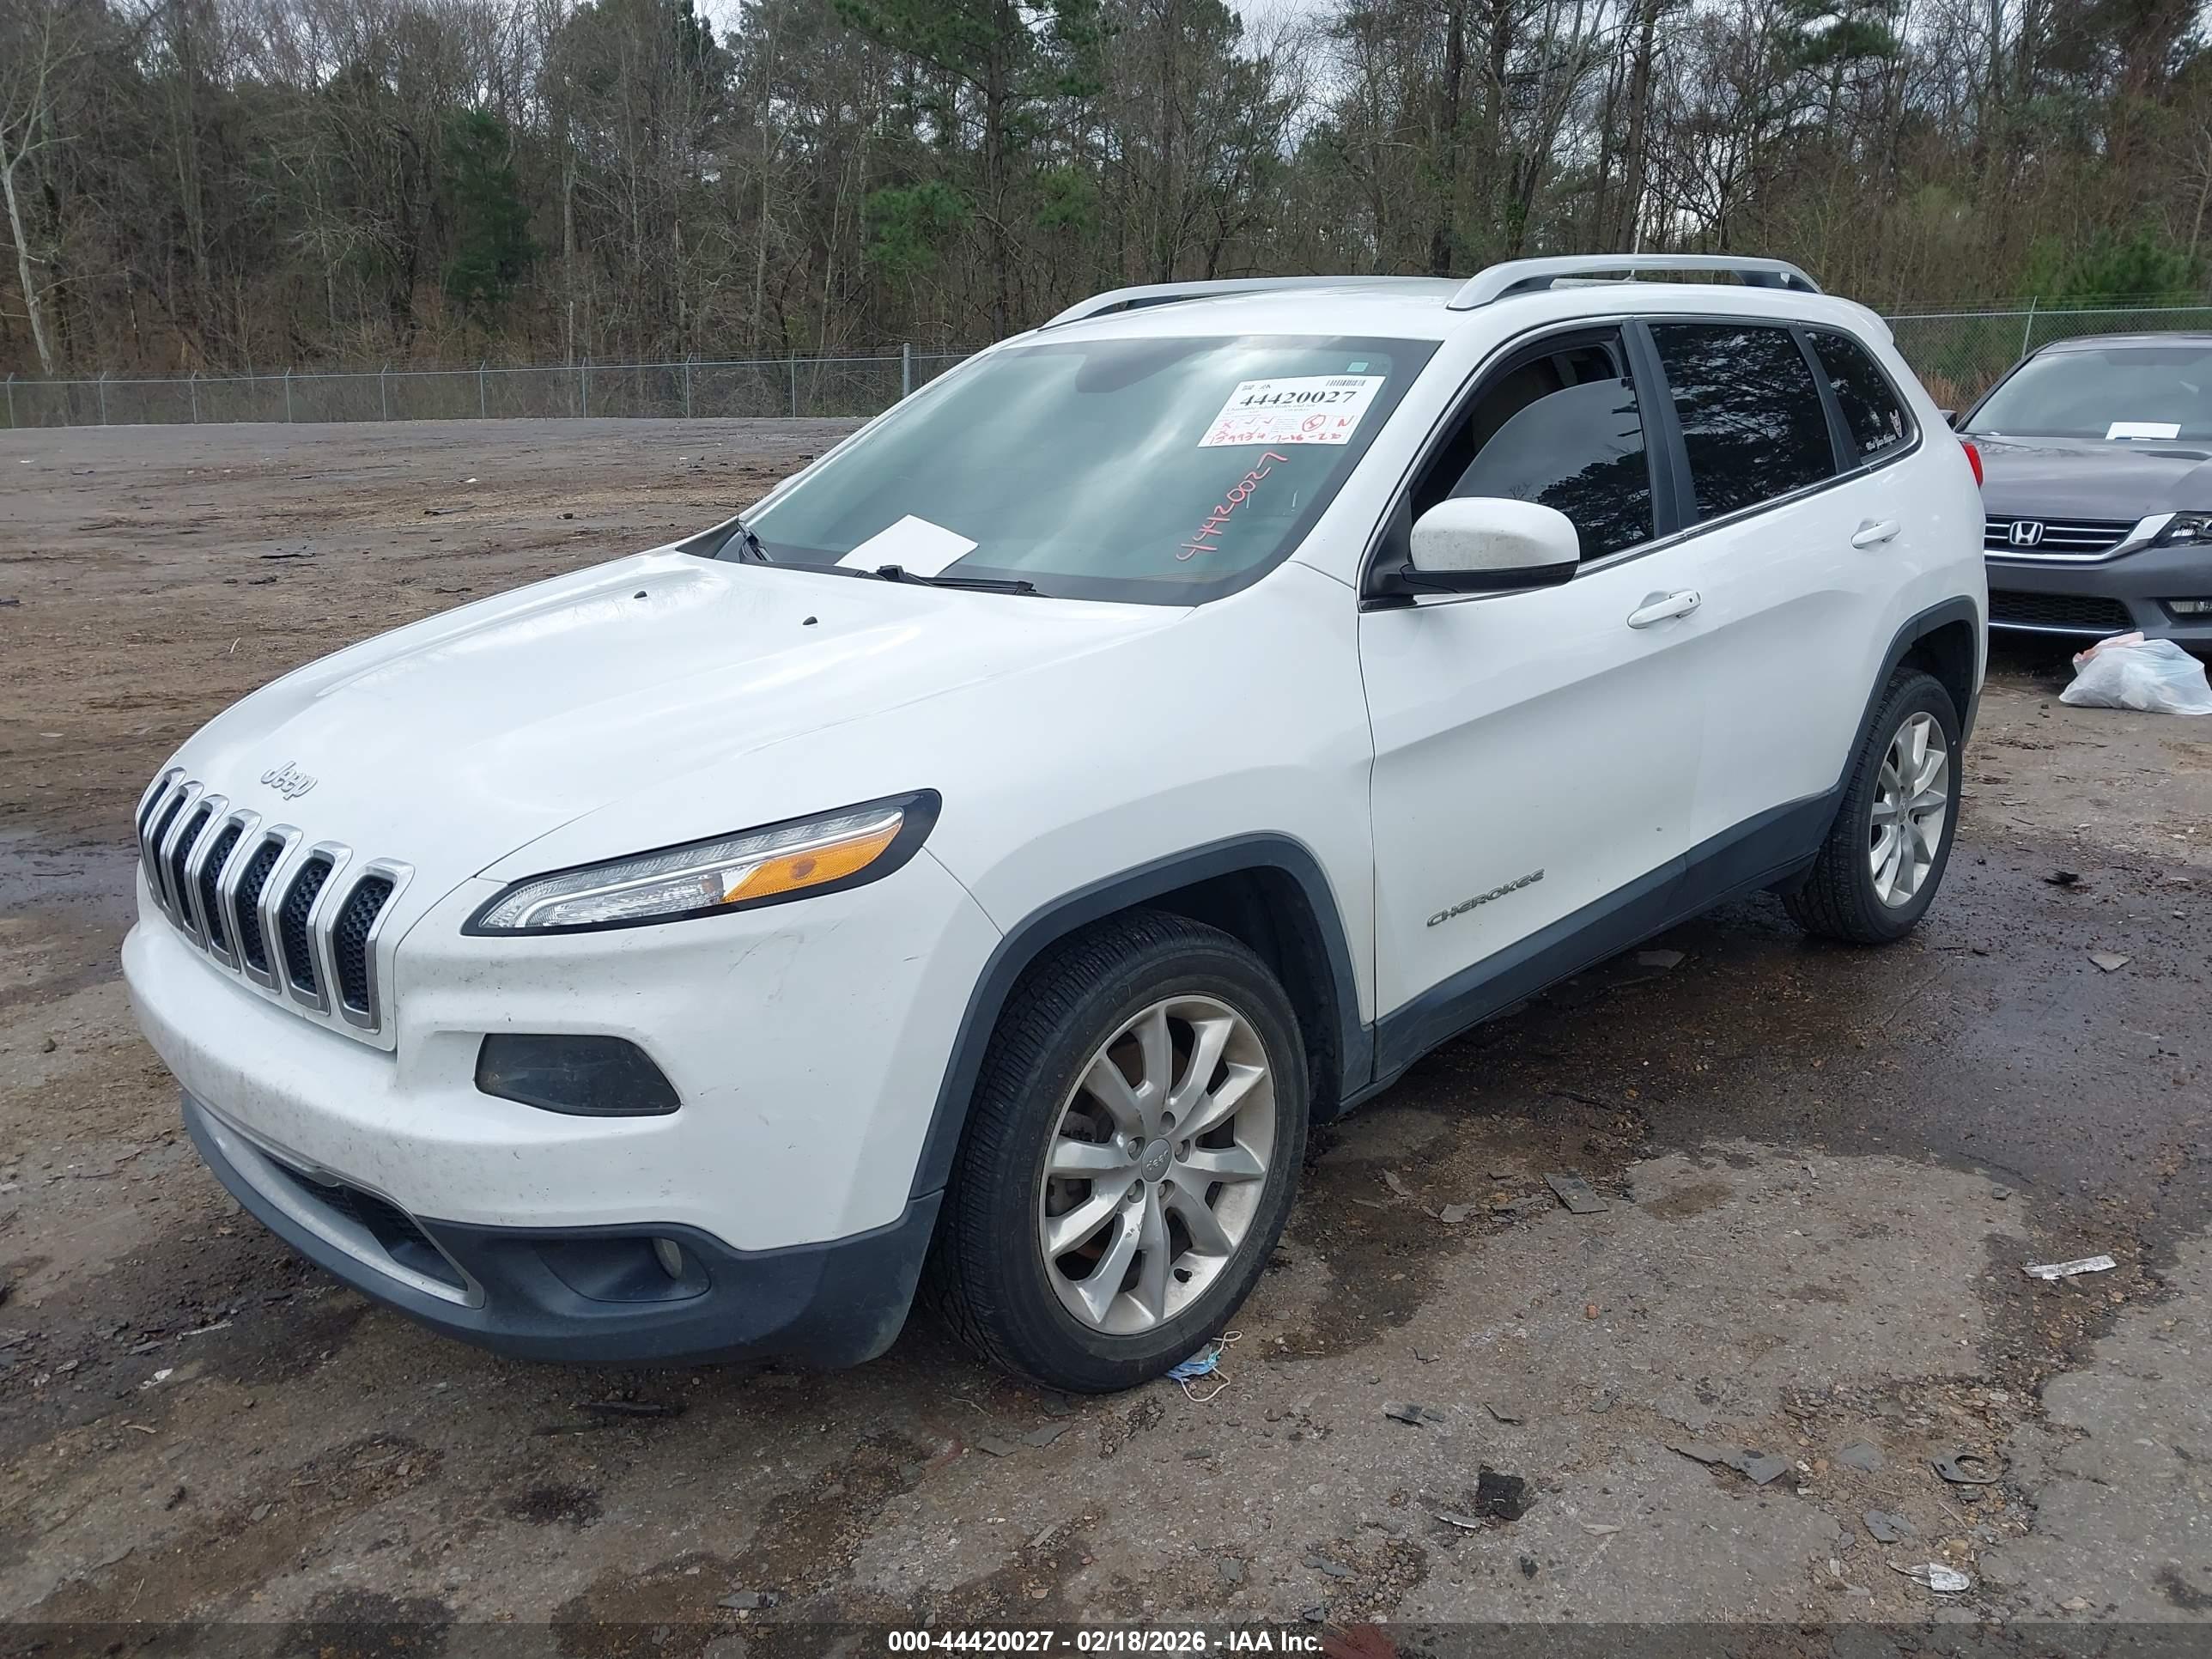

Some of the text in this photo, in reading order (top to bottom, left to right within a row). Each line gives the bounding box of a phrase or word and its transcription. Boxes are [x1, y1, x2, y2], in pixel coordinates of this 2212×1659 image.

[1239, 391, 1358, 407] 44420027
[1176, 452, 1288, 560] 44420027
[260, 760, 318, 801] Jeep
[1426, 867, 1546, 927] CHEROKEE
